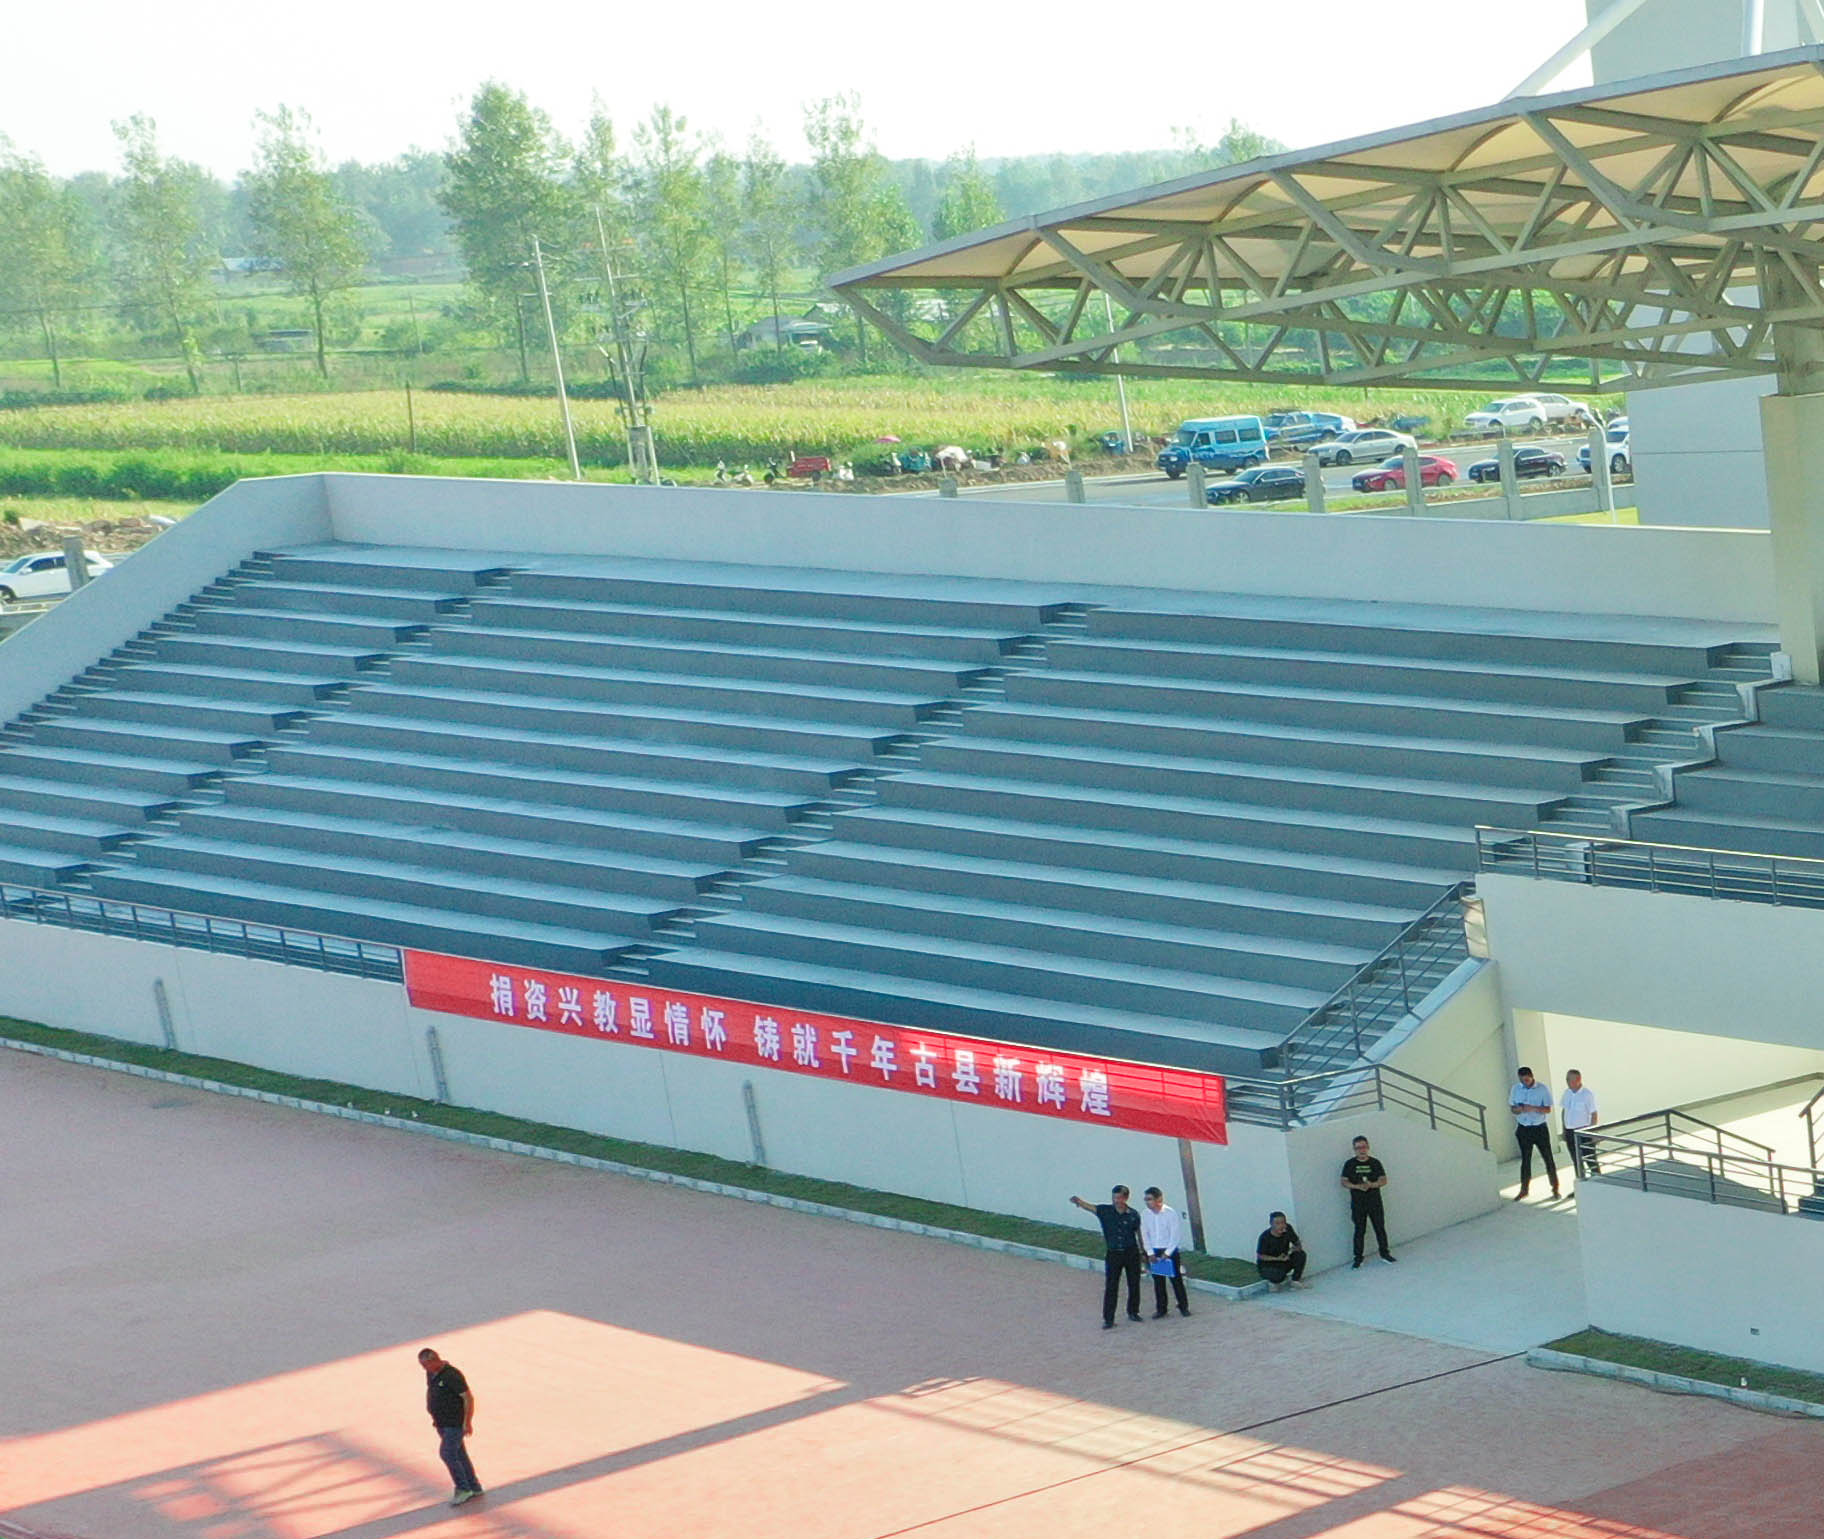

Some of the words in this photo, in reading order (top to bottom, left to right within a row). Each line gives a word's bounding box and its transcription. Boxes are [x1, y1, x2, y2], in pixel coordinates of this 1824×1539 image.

[489, 973, 727, 1051] 捐资兴教显情怀
[753, 1015, 1112, 1117] 铸就千年古县新辉煌
